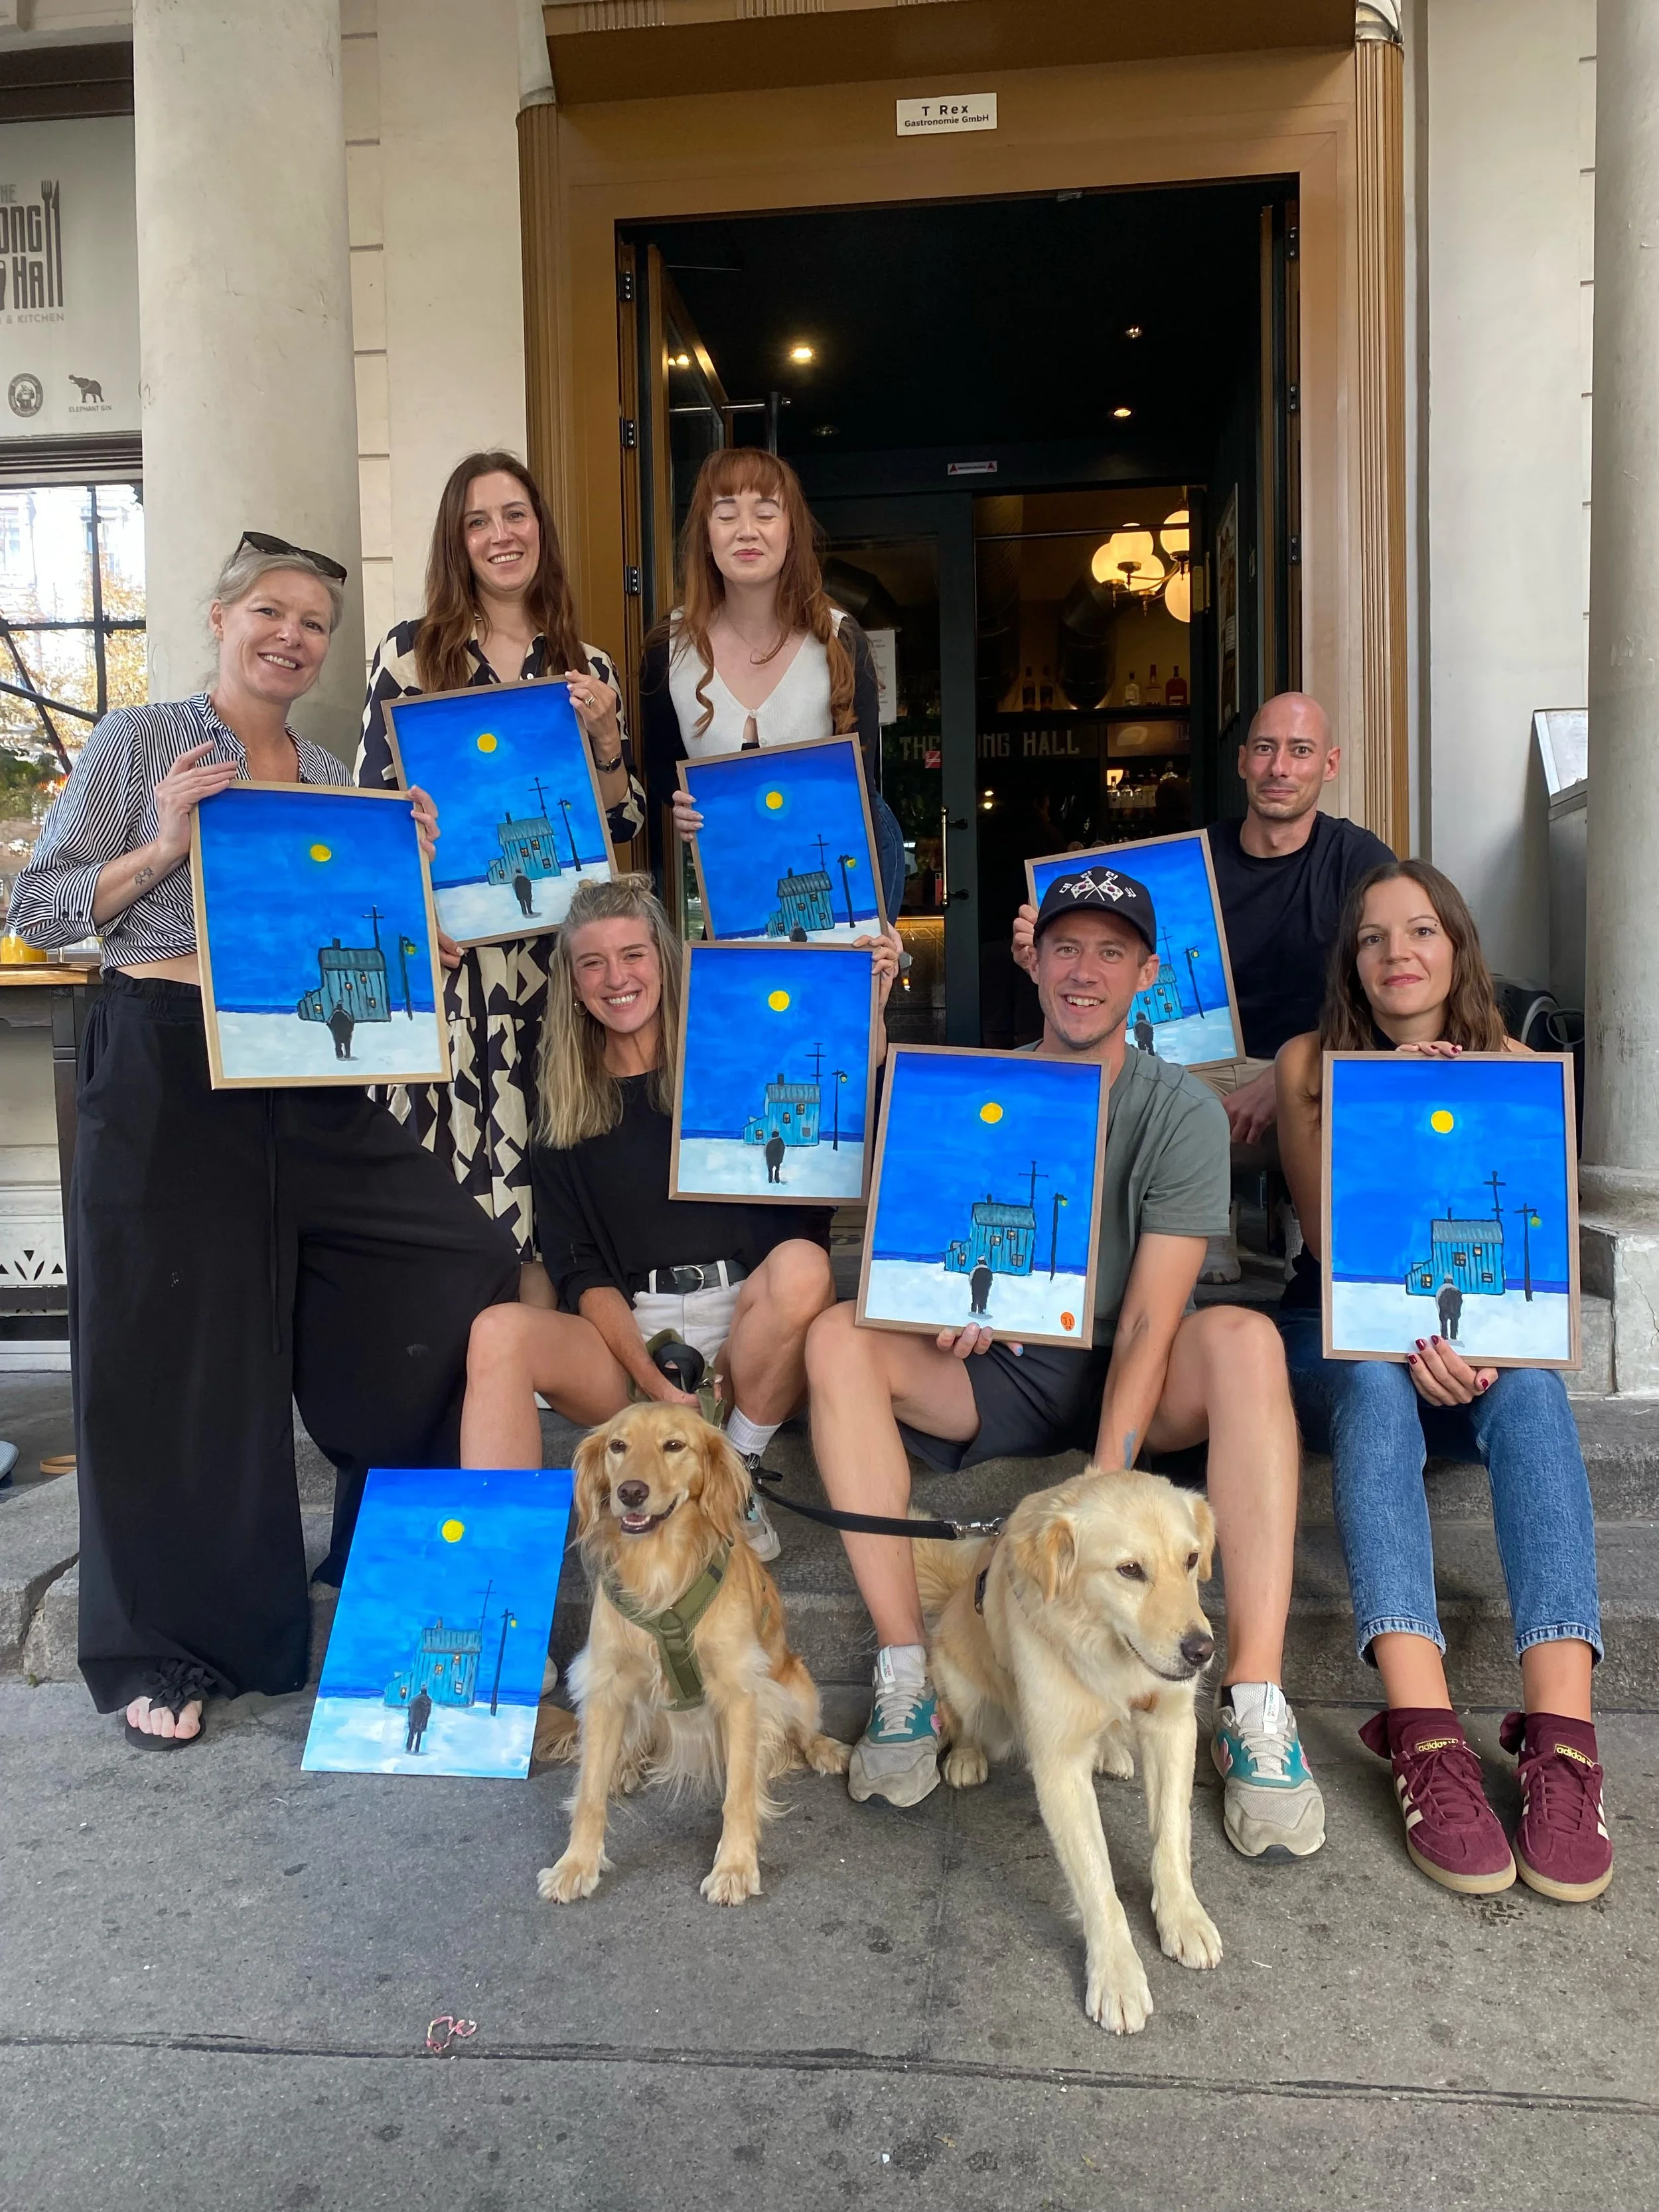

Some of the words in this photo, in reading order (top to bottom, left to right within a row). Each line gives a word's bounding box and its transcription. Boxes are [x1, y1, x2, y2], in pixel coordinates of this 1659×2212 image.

[922, 106, 930, 116] T
[940, 105, 969, 115] Rex
[904, 117, 960, 127] Gastronomie
[962, 114, 989, 123] GmbH
[0, 184, 17, 203] HE
[0, 205, 42, 254] ONG
[17, 313, 64, 323] KITCHEN
[1023, 729, 1080, 757] HALL
[1556, 1747, 1586, 1764] adidas
